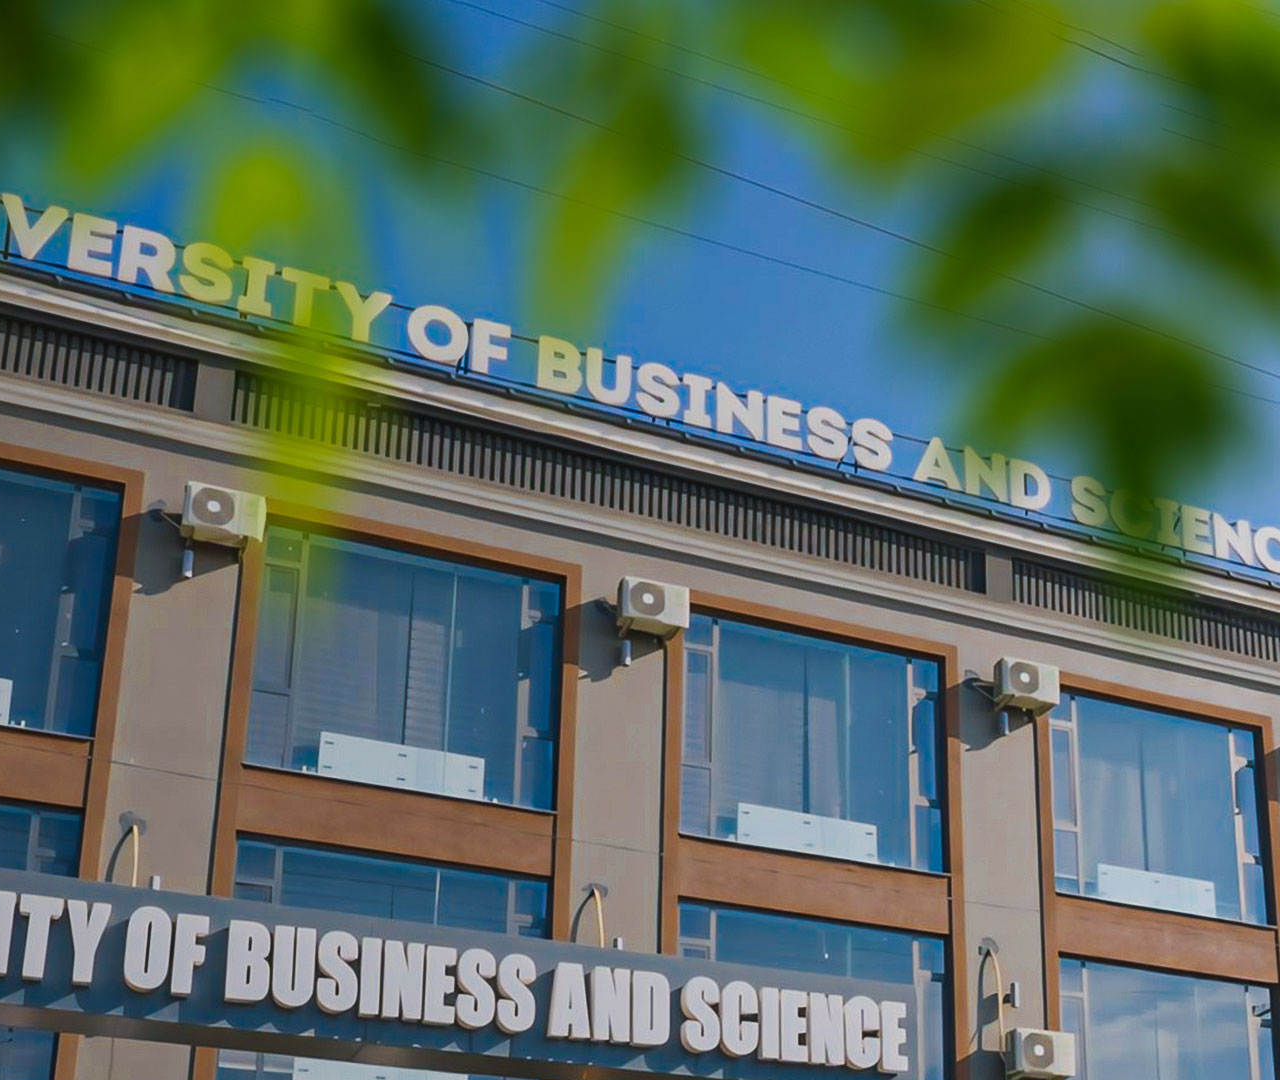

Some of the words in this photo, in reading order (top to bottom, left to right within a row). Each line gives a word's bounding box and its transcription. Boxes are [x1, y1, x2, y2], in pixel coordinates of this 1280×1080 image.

[407, 304, 512, 374] OF
[536, 334, 894, 473] BUSINESS
[913, 436, 1052, 512] AND
[123, 906, 210, 996] OF
[224, 918, 537, 1035] BUSINESS
[546, 962, 671, 1048] AND
[680, 976, 909, 1073] SCIENCE
